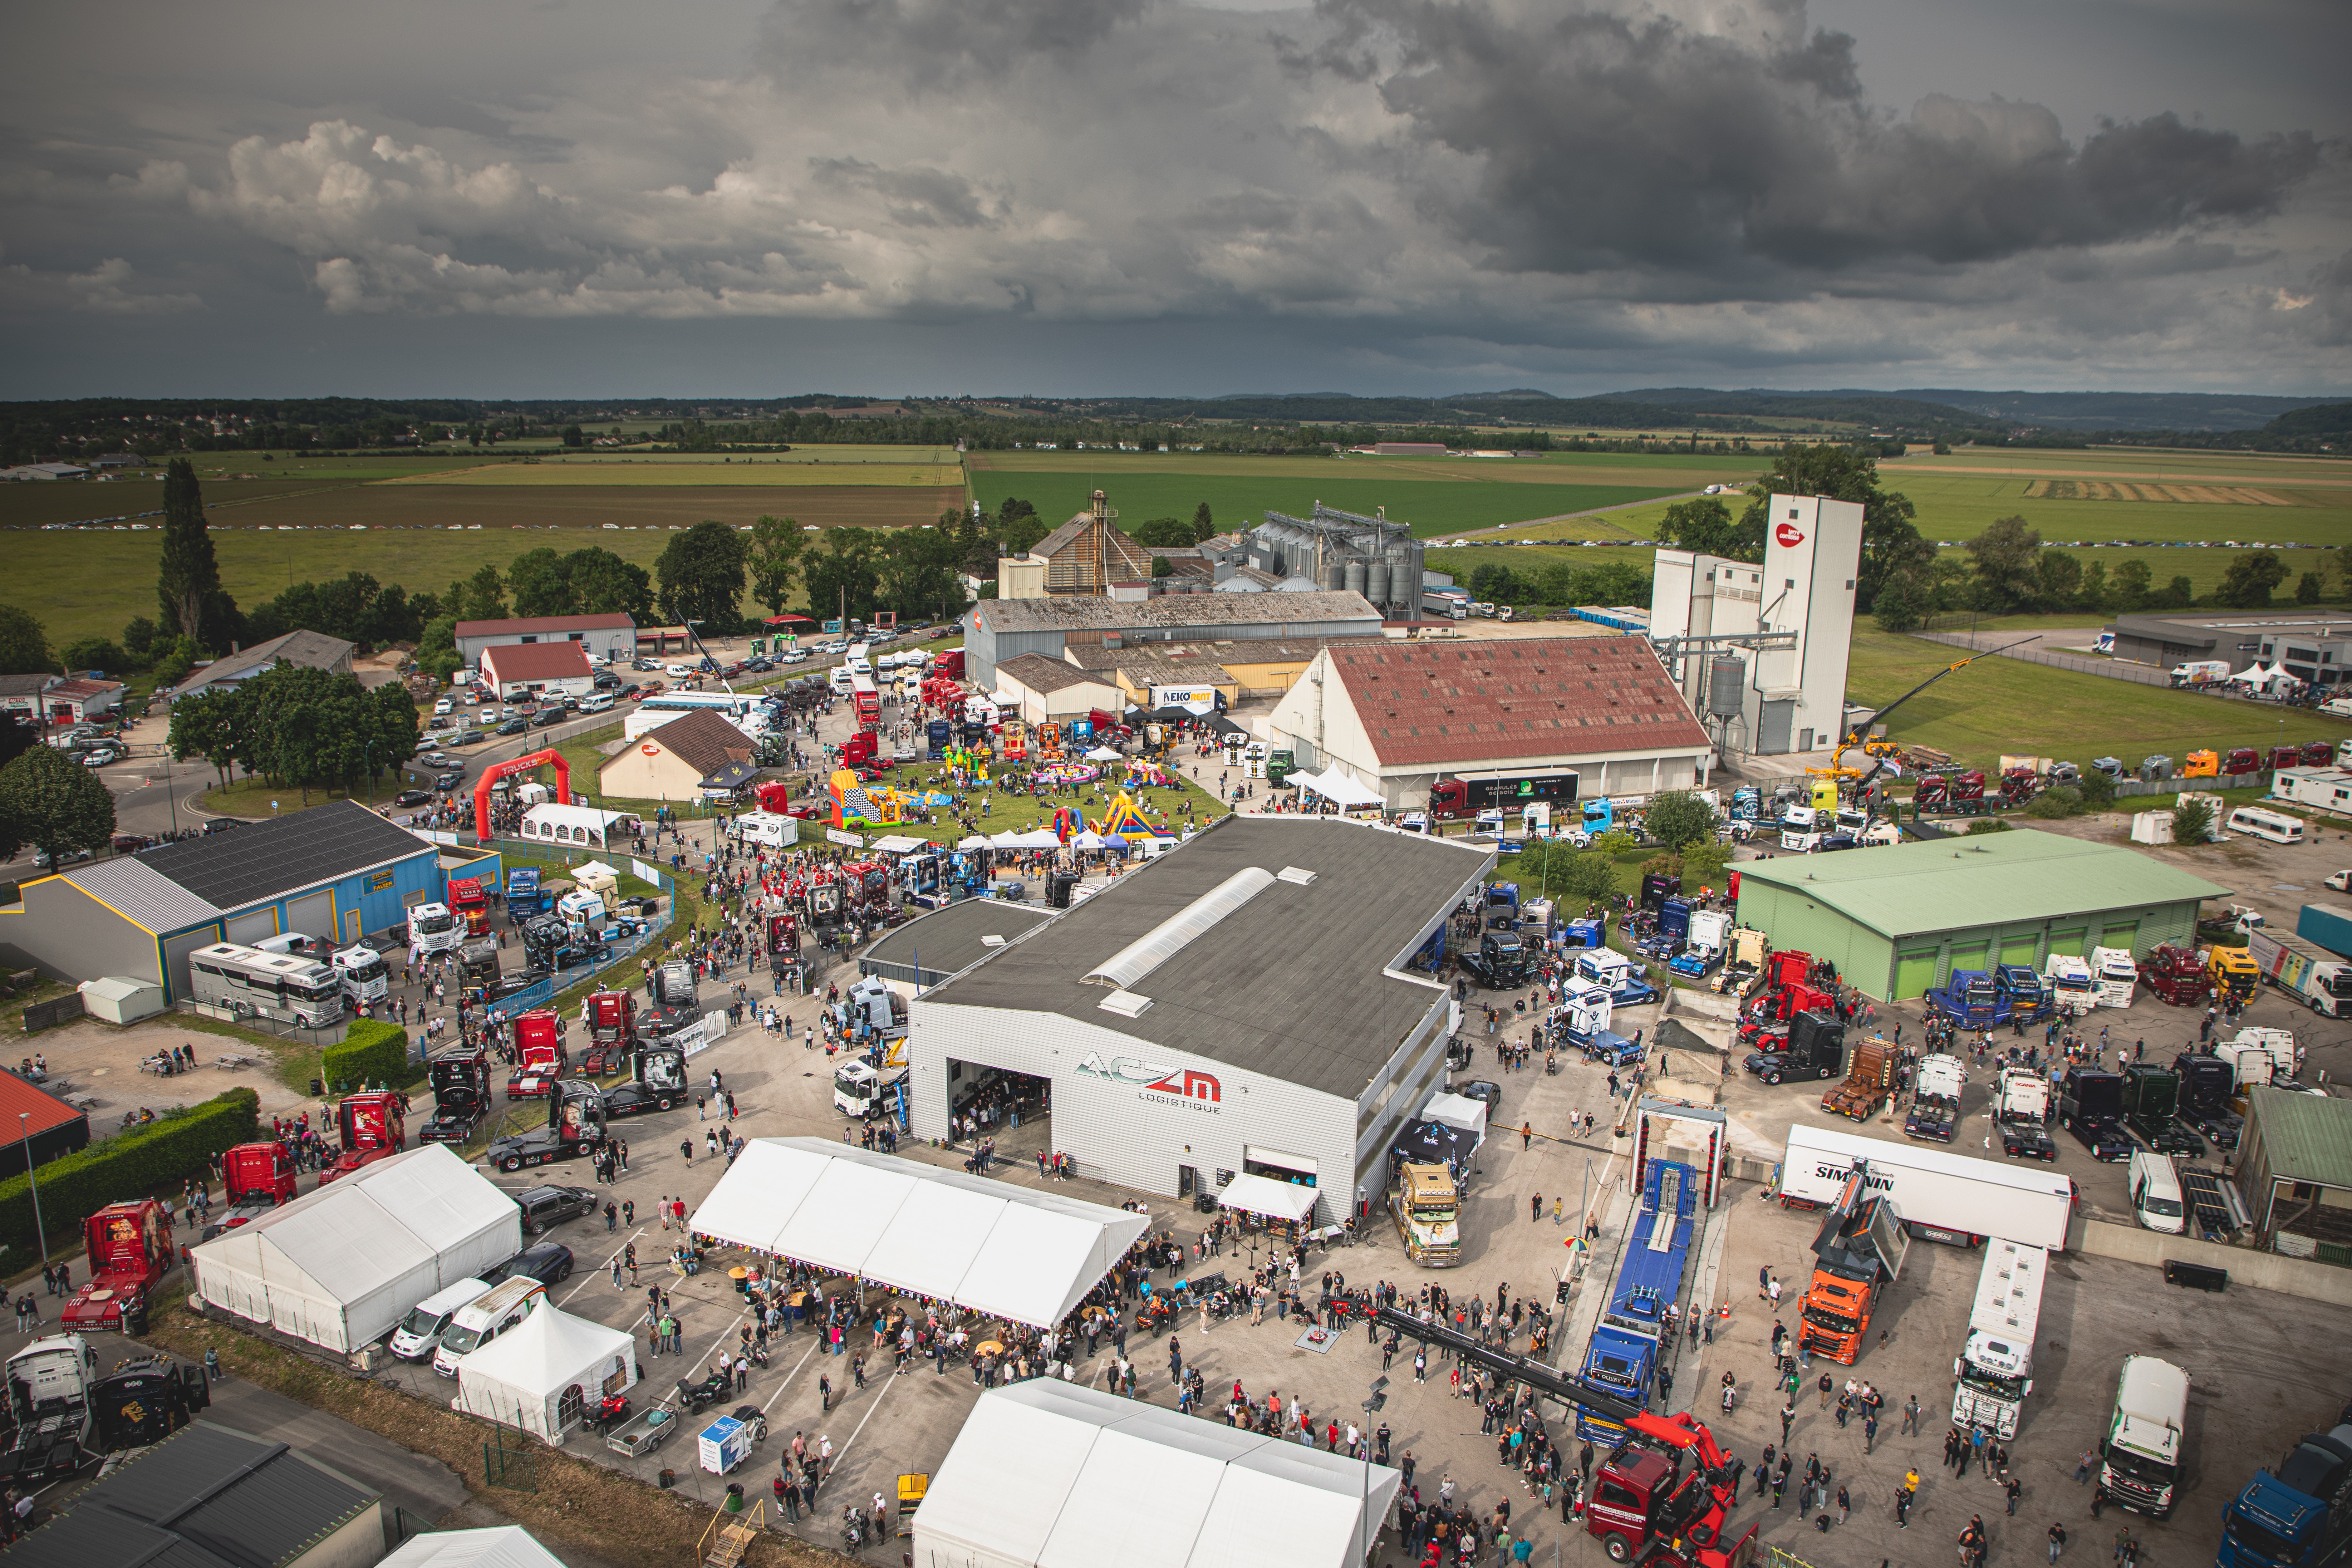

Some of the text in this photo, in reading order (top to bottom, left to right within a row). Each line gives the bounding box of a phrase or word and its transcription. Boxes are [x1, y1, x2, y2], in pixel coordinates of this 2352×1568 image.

[373, 882, 393, 891] FAVIER
[1139, 1092, 1221, 1115] LOGISTIQUE
[1870, 1169, 1894, 1179] Transports
[1815, 1170, 1894, 1191] SIMNIN
[1926, 1231, 1951, 1239] CHEREAU
[1601, 1374, 1621, 1383] OLIVRY
[1976, 1367, 2010, 1380] CHEVAUX
